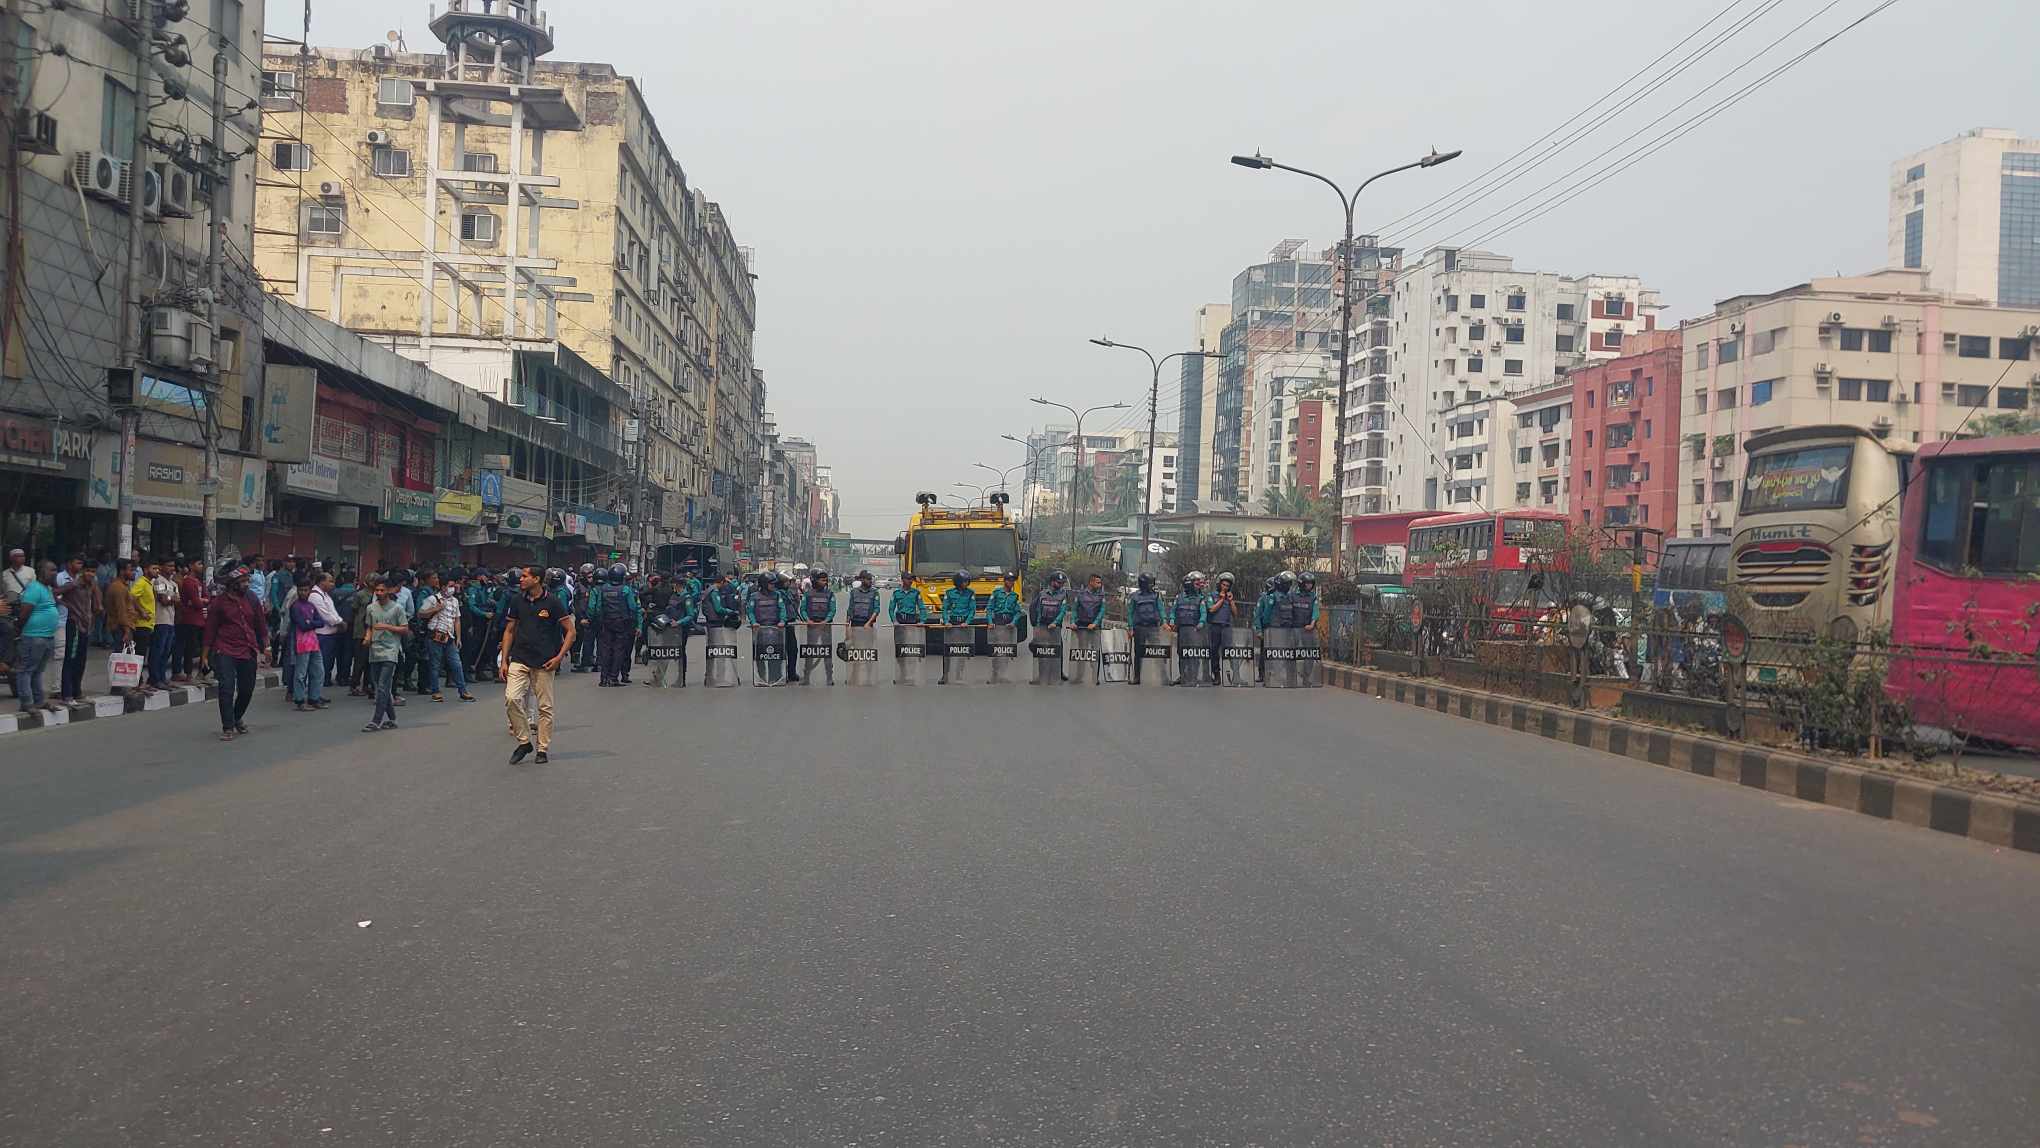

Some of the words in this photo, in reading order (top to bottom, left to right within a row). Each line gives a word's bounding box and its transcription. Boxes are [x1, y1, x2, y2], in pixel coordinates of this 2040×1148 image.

[53, 429, 90, 461] PARK
[149, 464, 182, 481] RASHID
[650, 648, 680, 657] POLICE
[707, 647, 735, 656] POLICE
[801, 647, 830, 656] POLICE
[848, 649, 876, 660] POLICE
[900, 647, 921, 655] POLICE
[949, 646, 970, 654] POLICE
[993, 646, 1014, 654] POLICE
[1036, 647, 1056, 655] POLICE
[1145, 647, 1166, 656] POLICE
[1182, 648, 1210, 657] POLICE
[1224, 648, 1252, 658] POLICE
[1266, 649, 1295, 659] POLICE
[1071, 649, 1097, 661] POLICE
